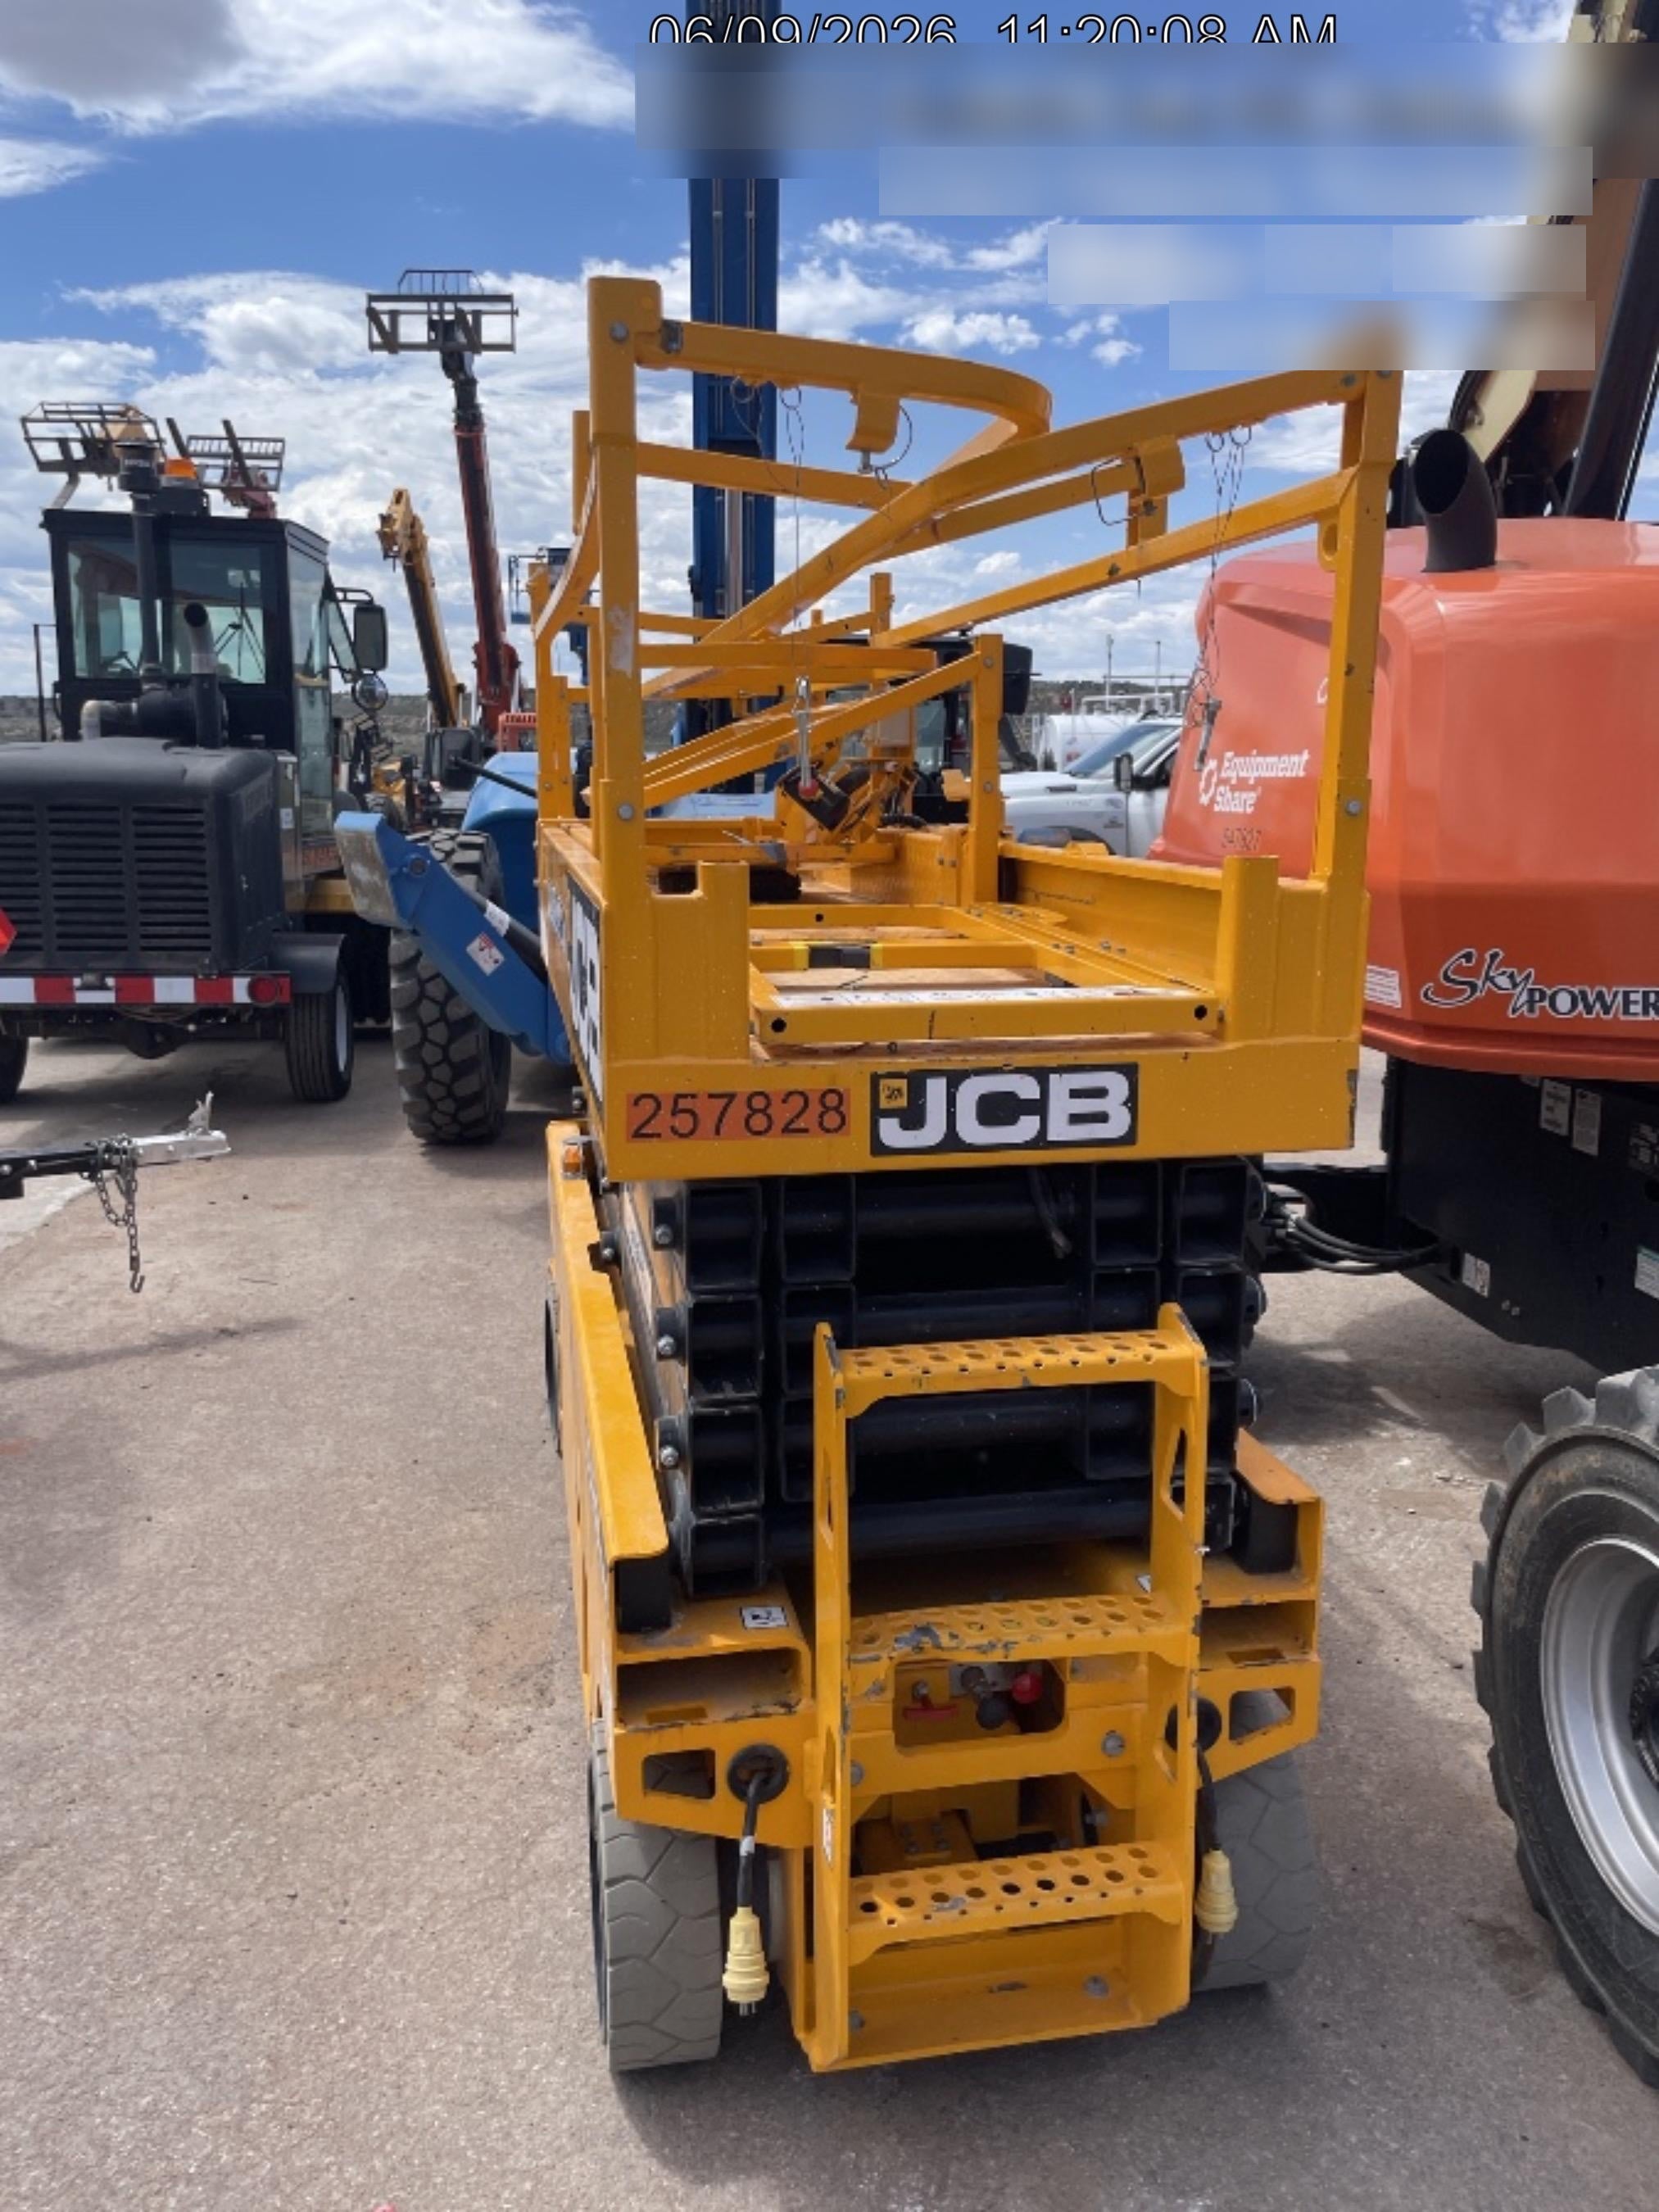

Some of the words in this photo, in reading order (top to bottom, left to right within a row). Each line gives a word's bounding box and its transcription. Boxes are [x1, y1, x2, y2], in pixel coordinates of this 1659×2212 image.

[1220, 749, 1310, 785] Equipment
[1213, 785, 1258, 814] Share
[630, 1088, 848, 1140] 257828
[878, 1070, 1131, 1149] JCB
